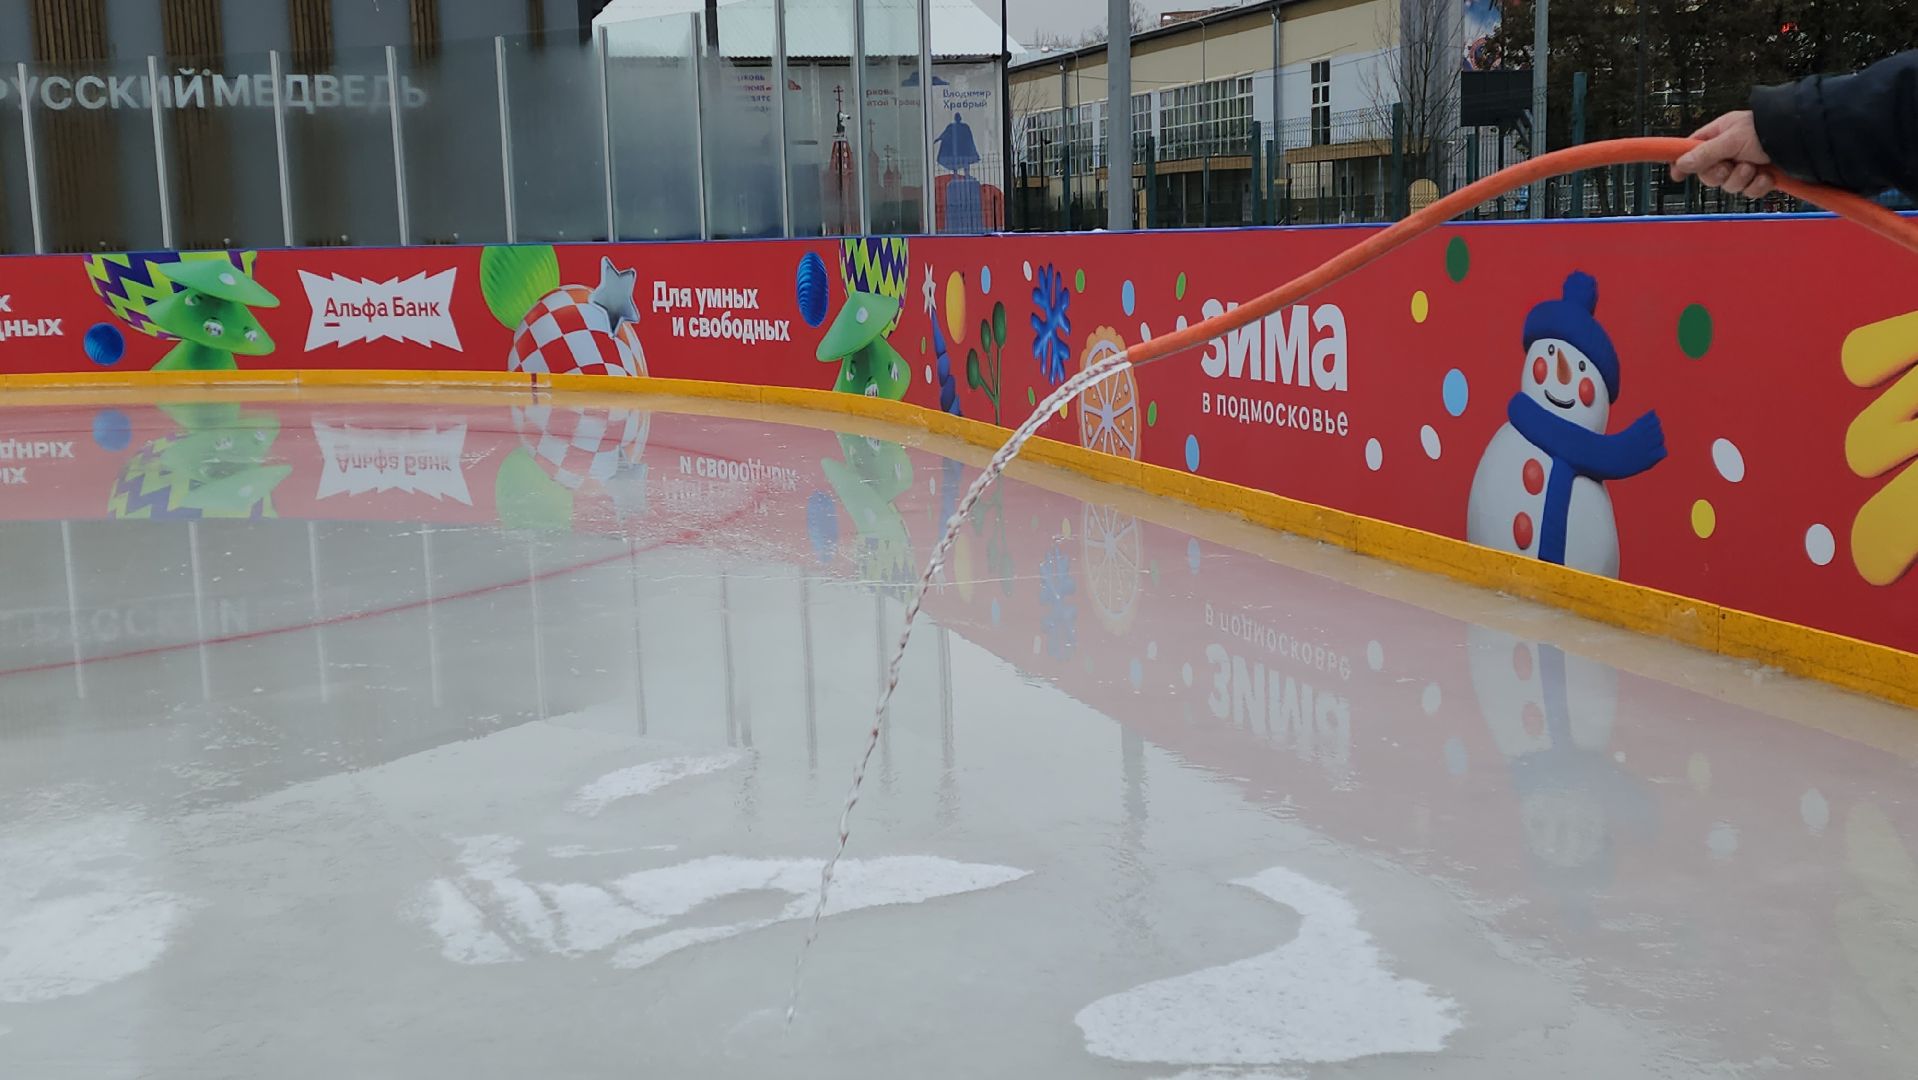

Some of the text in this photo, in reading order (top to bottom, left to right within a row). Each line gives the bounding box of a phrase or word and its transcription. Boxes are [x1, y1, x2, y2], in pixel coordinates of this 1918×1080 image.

[943, 100, 988, 111] Храбрый
[324, 296, 441, 326] Альфа Банк
[652, 281, 760, 315] Для умных
[672, 311, 791, 345] и свободных
[1202, 392, 1348, 436] в подмосковье
